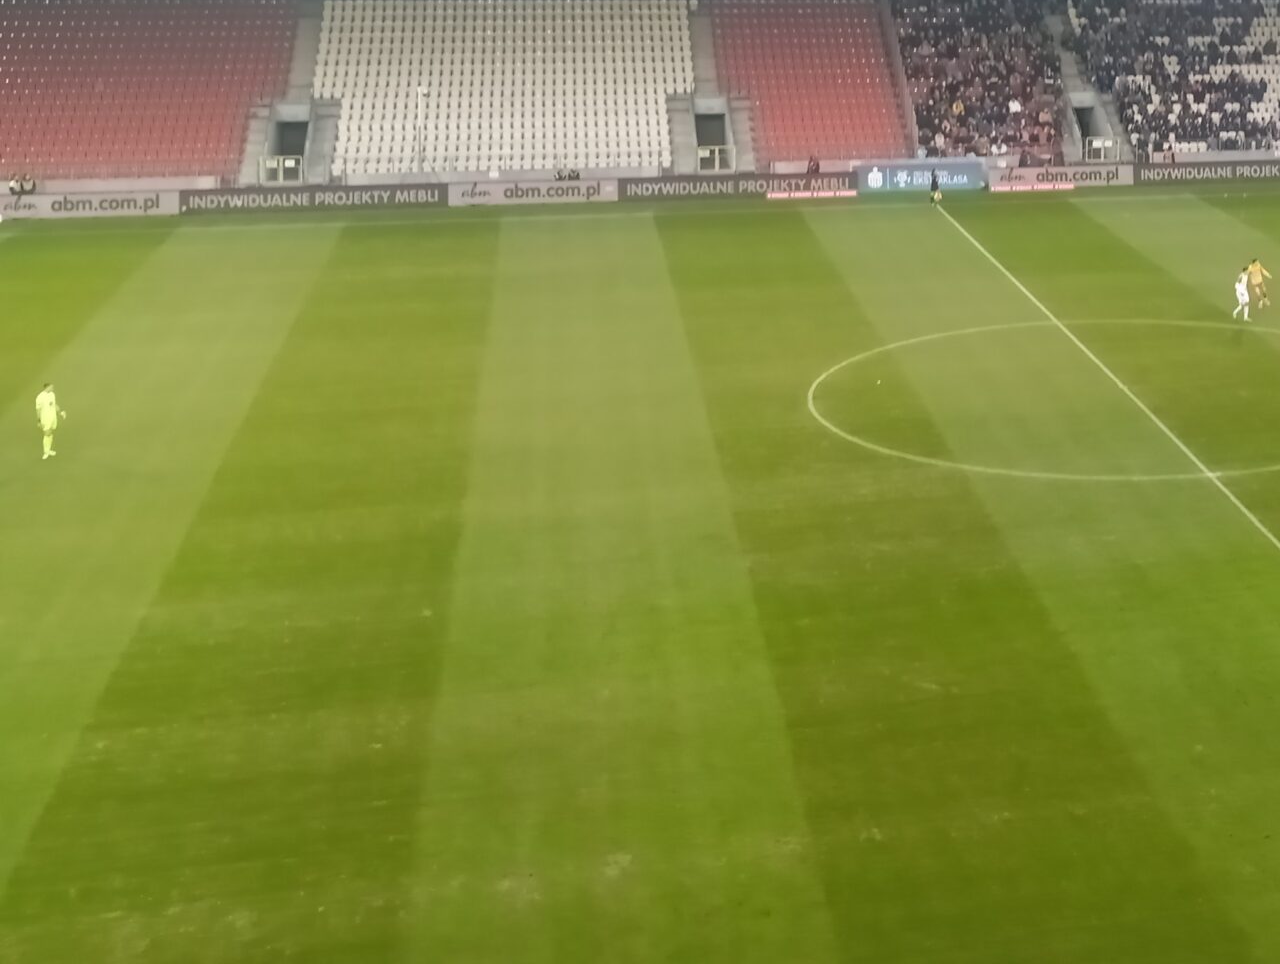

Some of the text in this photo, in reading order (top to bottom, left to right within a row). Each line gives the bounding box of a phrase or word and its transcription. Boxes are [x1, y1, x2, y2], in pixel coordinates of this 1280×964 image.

[1036, 166, 1119, 184] abm.com.pl
[1141, 166, 1232, 181] INDYWIDUALNE
[503, 182, 600, 200] abm.com.pl
[627, 177, 849, 196] INDYWIDUALNE PROJEKTY MEBLI
[51, 193, 160, 214] abm.com.pl
[189, 189, 439, 211] INDYWIDUALNE PROJEKTY MEBLI
